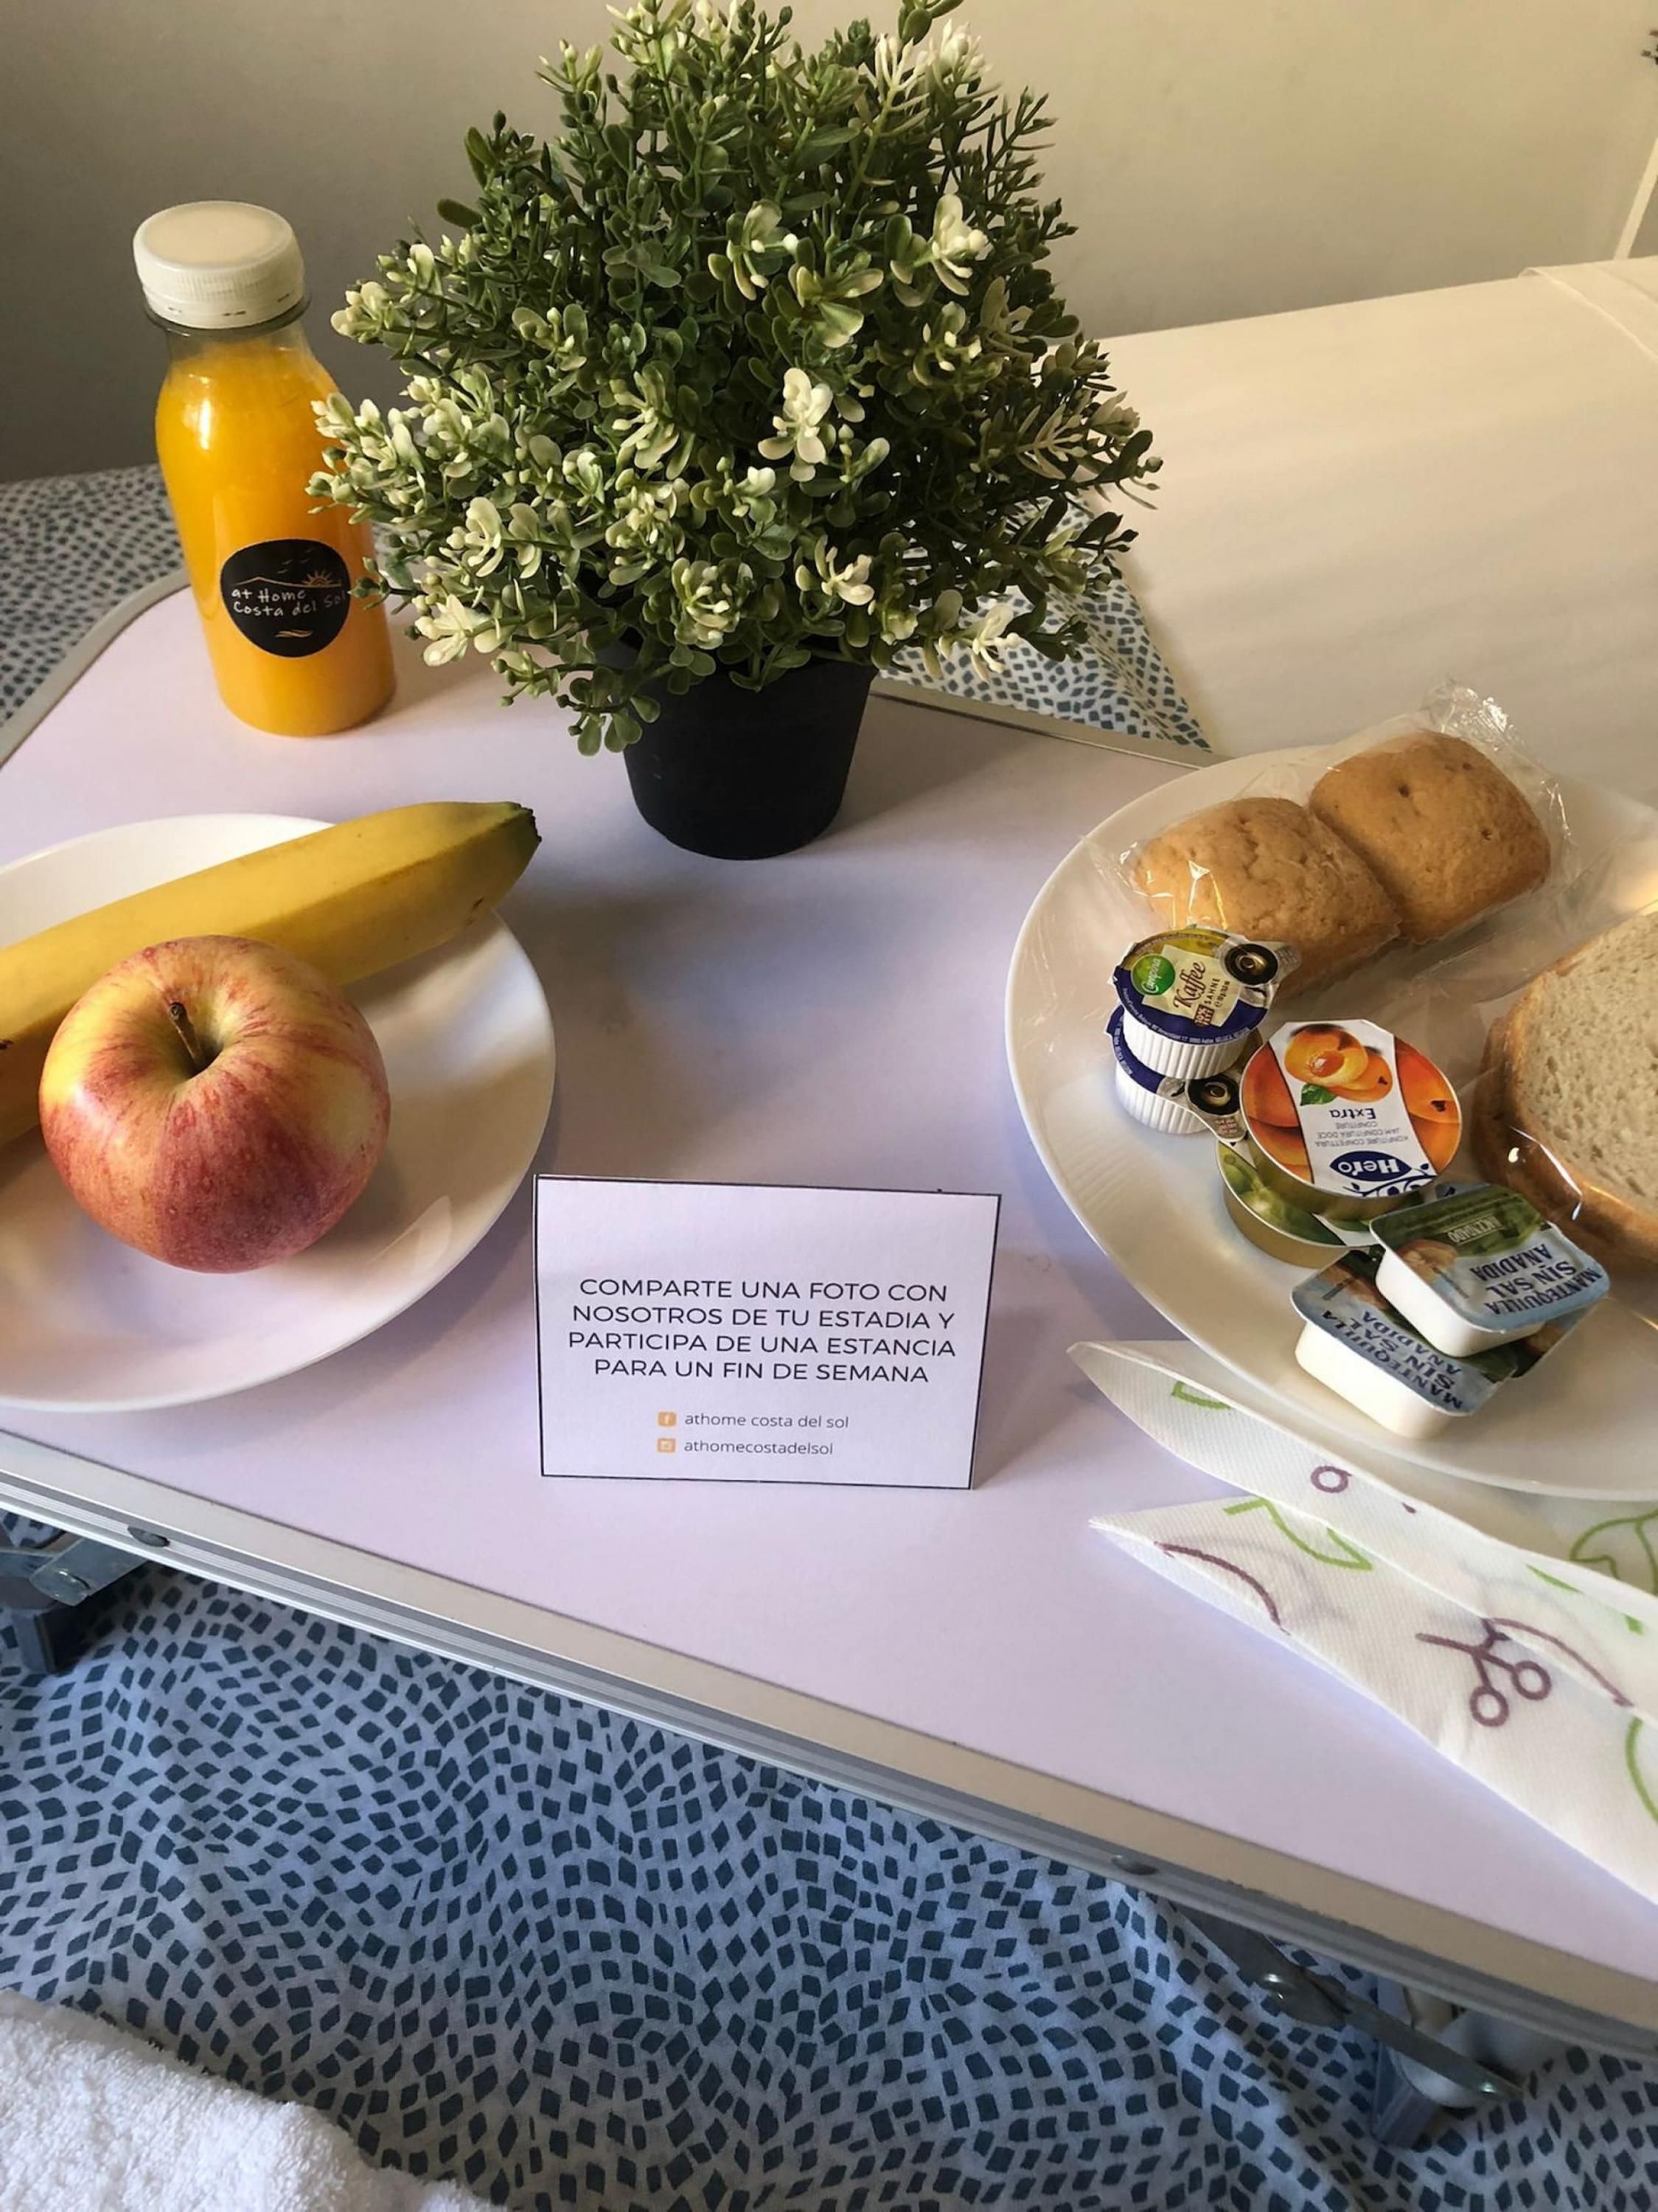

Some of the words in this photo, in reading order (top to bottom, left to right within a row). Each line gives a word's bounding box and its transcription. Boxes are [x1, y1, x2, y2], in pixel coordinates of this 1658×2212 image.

[231, 588, 253, 599] at
[258, 588, 307, 603] Home
[233, 601, 284, 616] Costa
[292, 600, 316, 616] del
[324, 590, 346, 608] Sol
[1173, 961, 1206, 1008] Kaffee
[1204, 978, 1221, 1005] SAHNE
[1329, 1107, 1376, 1120] Extra
[1337, 1158, 1400, 1176] Hero
[1469, 1244, 1553, 1281] AÑADIDA
[1532, 1261, 1577, 1285] SIN
[579, 1279, 733, 1298] COMPARTE
[742, 1281, 801, 1298] UNA
[809, 1282, 880, 1300] FOTO
[888, 1284, 947, 1301] CON
[1483, 1267, 1603, 1315] MANTEQUILLA
[1485, 1276, 1533, 1299] SAL
[573, 1305, 722, 1324] NOSOTROS
[732, 1309, 768, 1326] DE
[776, 1310, 809, 1326] TU
[819, 1310, 930, 1329] ESTADIA
[938, 1312, 955, 1329] Y
[569, 1332, 707, 1352] PARTICIPA
[716, 1335, 752, 1352] DE
[760, 1336, 818, 1354] UNA
[827, 1338, 956, 1357] ESTANCIA
[1350, 1317, 1399, 1352] SAL
[595, 1359, 667, 1377] PARA
[675, 1361, 713, 1377] UN
[722, 1362, 762, 1379] FIN
[773, 1363, 808, 1380] DE
[815, 1364, 929, 1382] SEMANA
[1321, 1310, 1463, 1409] MANTEQUILLA
[1404, 1355, 1457, 1390] SIN
[684, 1413, 747, 1427] athome
[750, 1416, 793, 1427] costa
[797, 1415, 822, 1428] del
[826, 1416, 849, 1428] sol
[683, 1439, 834, 1455] athomecostadelsol
